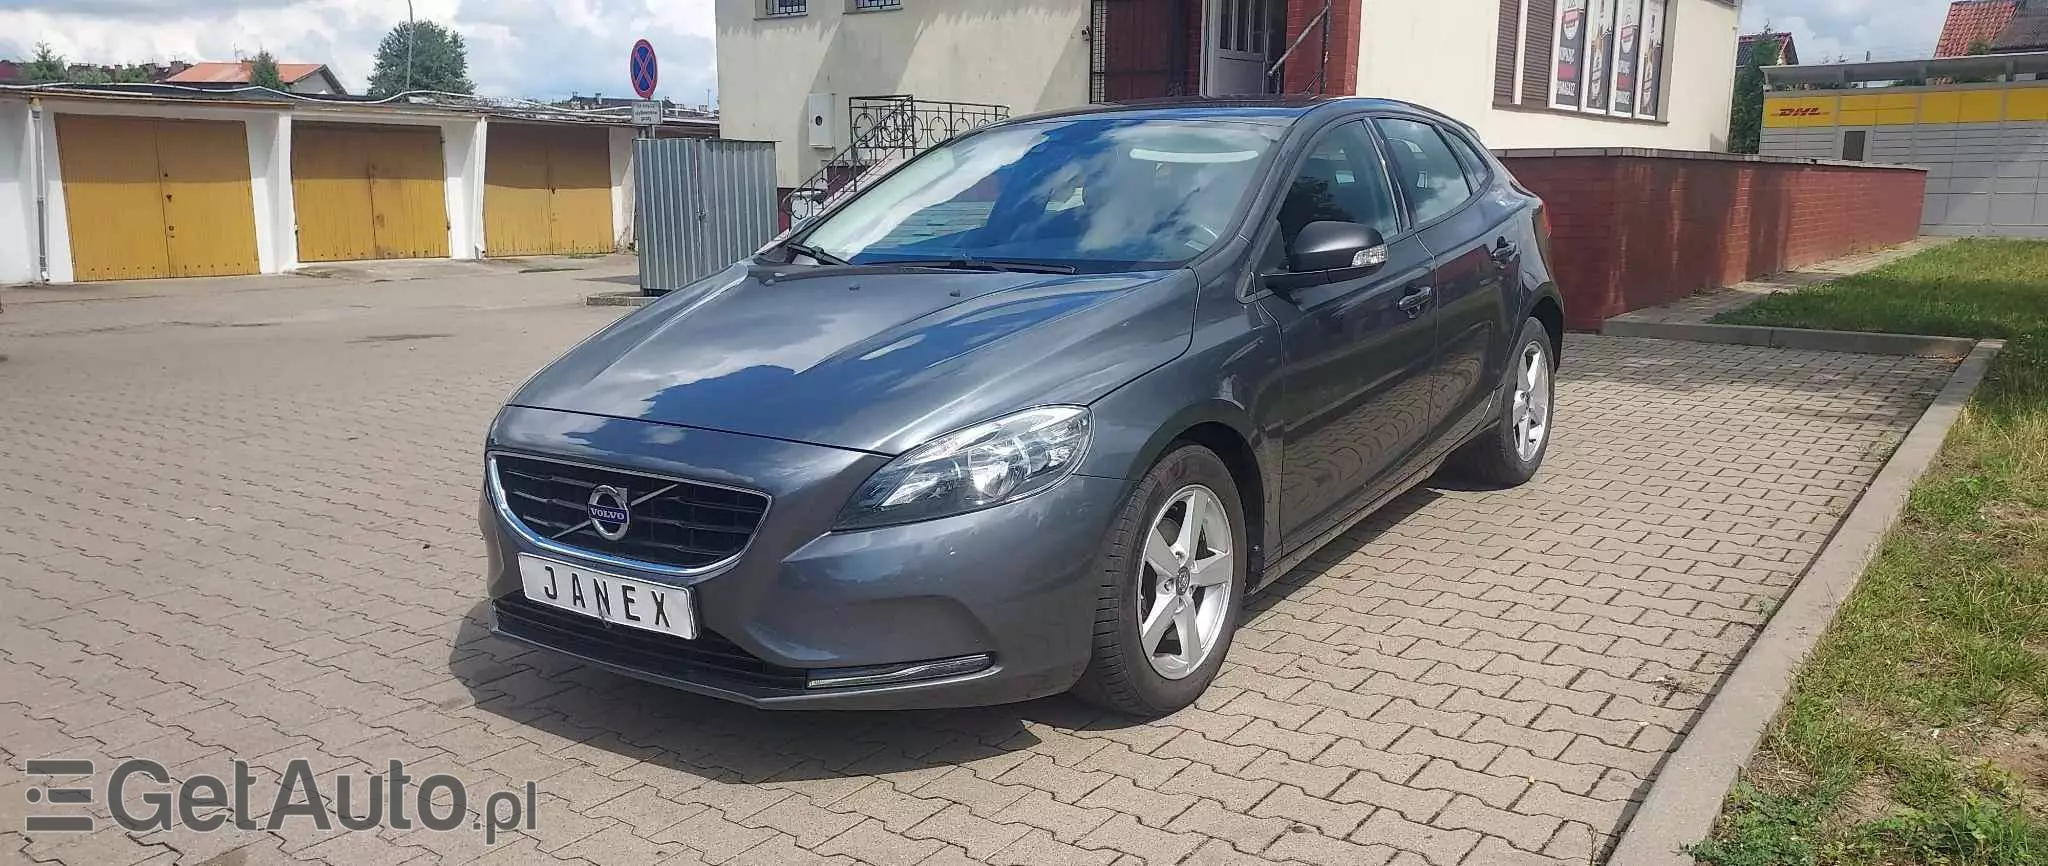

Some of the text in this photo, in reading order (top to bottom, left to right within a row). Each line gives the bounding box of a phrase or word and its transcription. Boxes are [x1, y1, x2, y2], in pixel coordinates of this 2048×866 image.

[1779, 107, 1820, 117] DHL
[590, 507, 625, 520] VOLVO
[544, 566, 671, 628] JANEX
